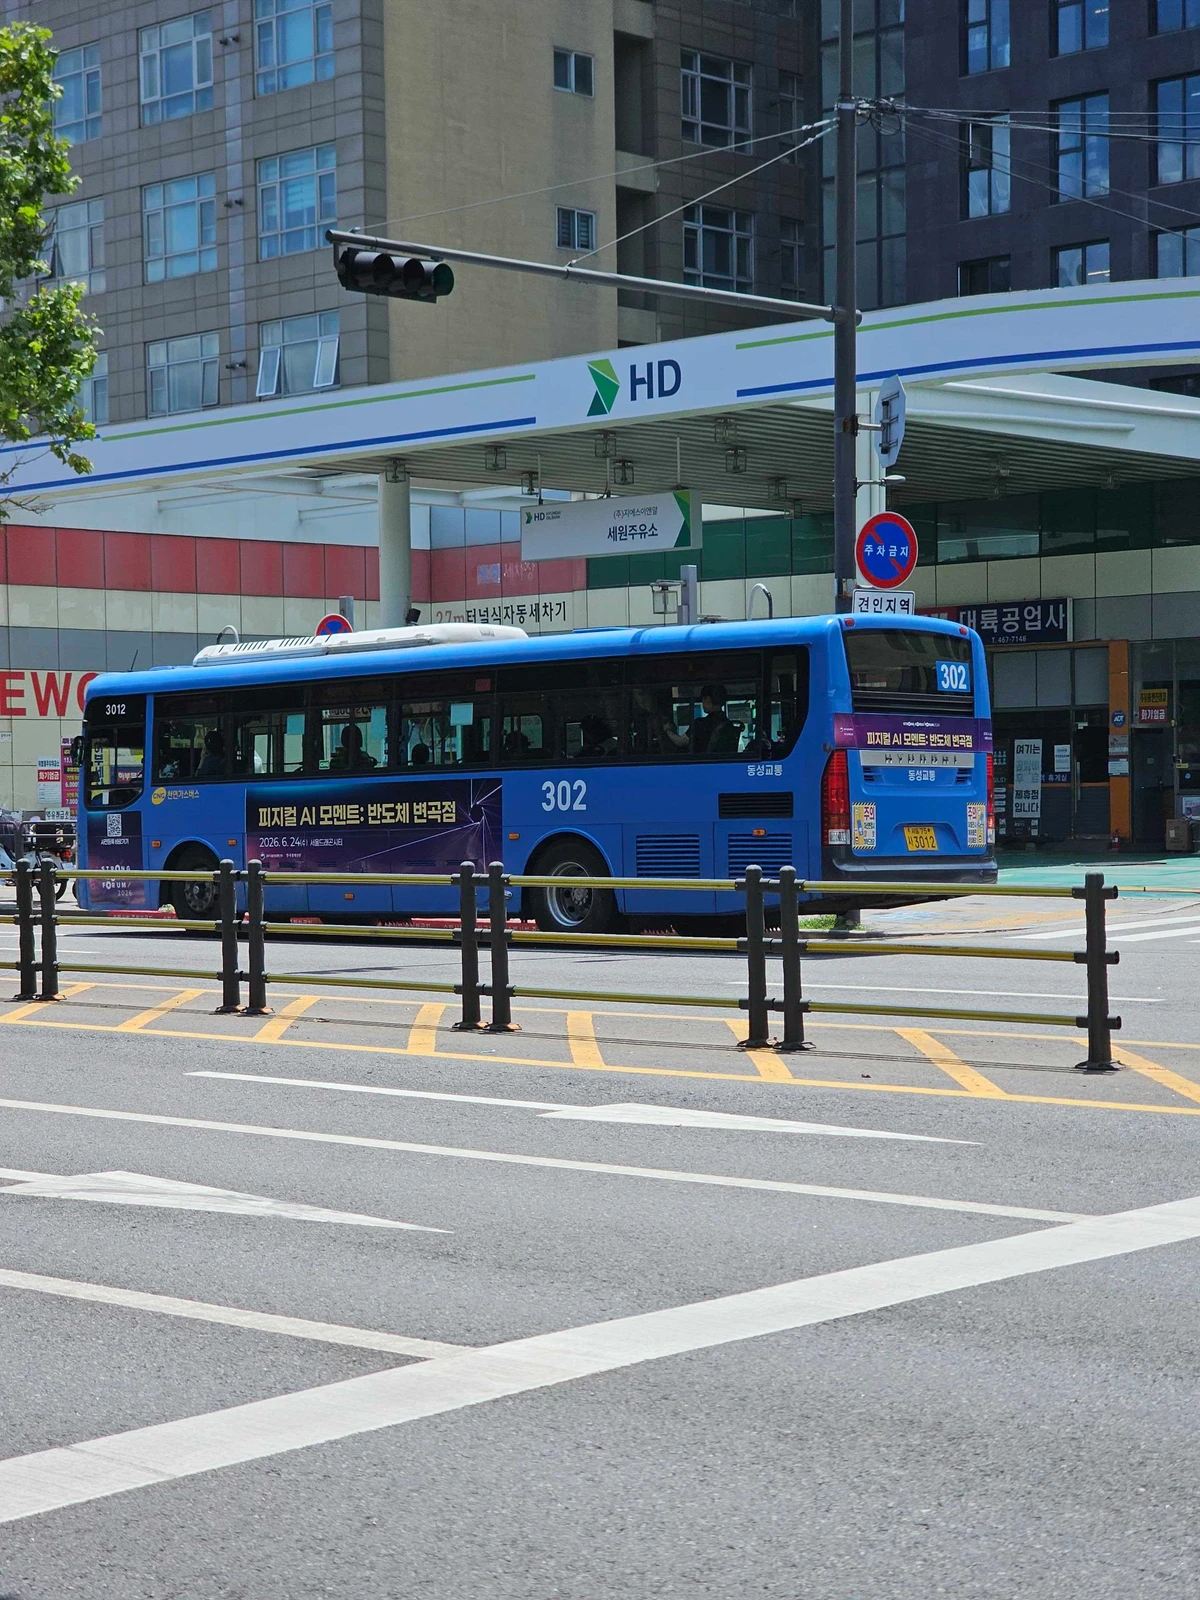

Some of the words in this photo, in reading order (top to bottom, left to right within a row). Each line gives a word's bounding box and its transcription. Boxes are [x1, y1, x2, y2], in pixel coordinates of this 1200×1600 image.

[630, 360, 681, 401] HD
[534, 512, 545, 521] HD
[607, 523, 658, 541] 세원주유소
[864, 545, 909, 557] 주차금지
[858, 597, 910, 614] 견인지역
[960, 604, 1065, 633] 대륙공업사
[941, 664, 967, 689] 302
[106, 704, 126, 715] 3012
[867, 732, 891, 745] 피지컬
[892, 733, 902, 745] AI
[930, 734, 951, 747] 반도체
[952, 735, 973, 748] 변곡점
[1016, 744, 1040, 754] 여기는
[747, 764, 783, 776] 동성교통
[908, 769, 935, 781] 동성교통
[541, 779, 587, 812] 302
[258, 806, 297, 827] 피지컬
[299, 806, 316, 826] AI
[319, 804, 364, 826] 모멘트:
[367, 802, 410, 824] 반도체
[413, 800, 456, 823] 변곡점
[1014, 802, 1039, 813] 입니다
[914, 836, 936, 849] 3012
